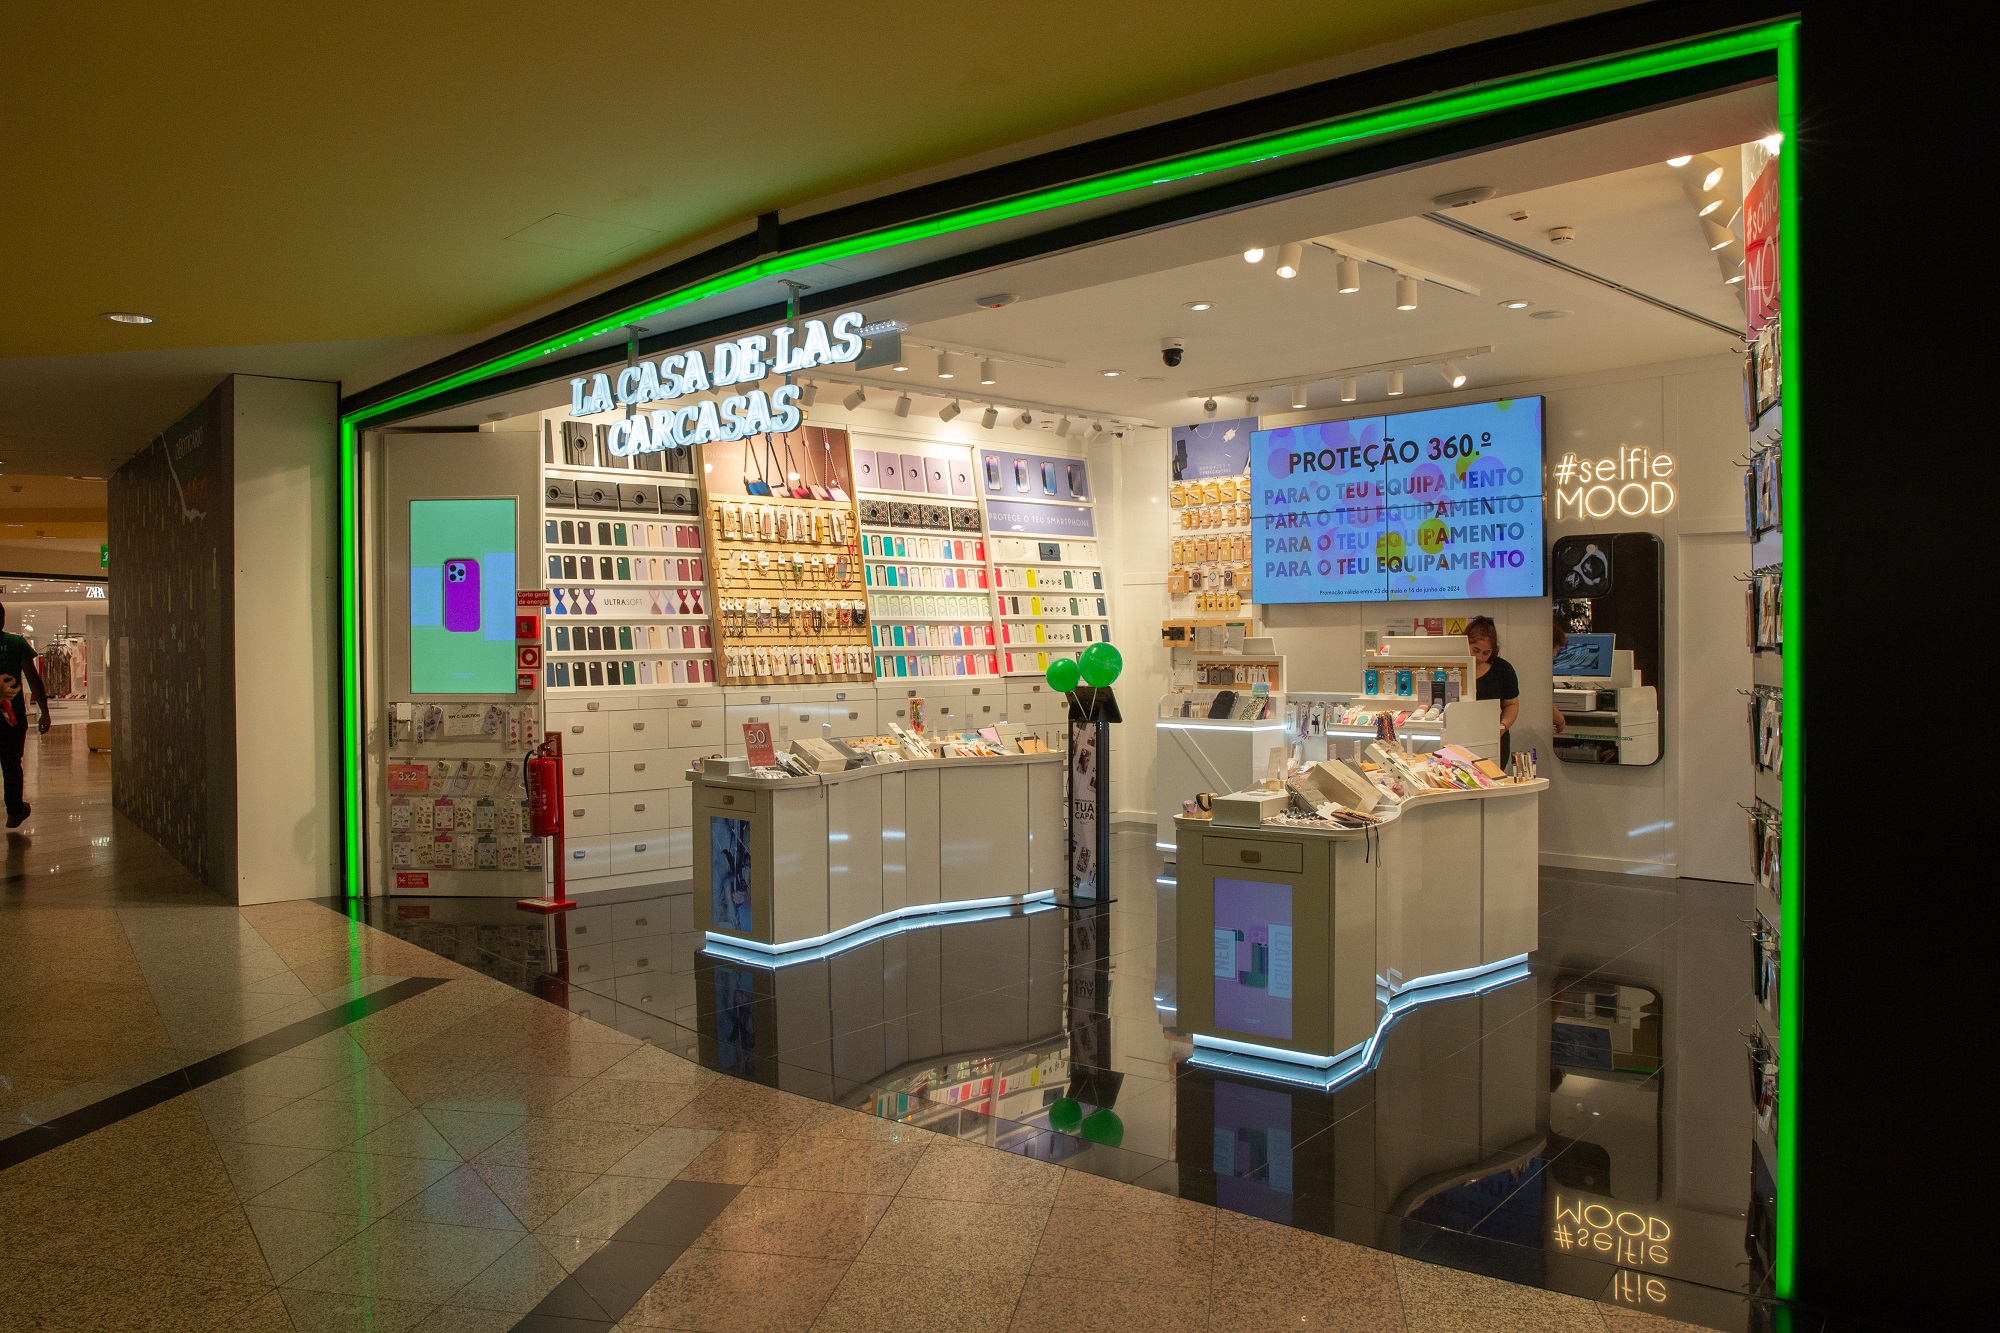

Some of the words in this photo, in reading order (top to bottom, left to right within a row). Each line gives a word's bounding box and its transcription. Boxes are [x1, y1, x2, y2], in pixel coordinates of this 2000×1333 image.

[1747, 178, 1780, 247] #somo
[1748, 222, 1780, 325] MO
[569, 372, 616, 417] LA
[617, 350, 711, 404] CASA
[714, 335, 768, 386] DE
[772, 312, 864, 374] LAS
[608, 384, 802, 456] CARCASAS
[1289, 437, 1419, 474] PROTEÇÃO
[1555, 446, 1673, 484] #selfie
[1264, 487, 1310, 506] PARA
[1316, 484, 1330, 502] O
[1336, 481, 1368, 500] TEU
[1376, 467, 1524, 496] EQUIPAMENTO
[1557, 482, 1674, 520] MOOD
[989, 512, 1020, 522] PROTEGE
[1047, 517, 1090, 527] SMARTPHONE
[1264, 511, 1312, 530] PARA
[1317, 509, 1331, 526] O
[1336, 506, 1369, 525] TEU
[1376, 494, 1524, 522] EQUIPAMENTO
[1265, 536, 1312, 554] PARA
[1317, 534, 1332, 551] O
[1337, 532, 1369, 550] TEU
[1376, 522, 1524, 548] EQUIPAMENTO
[1265, 560, 1312, 578] PARA
[1317, 559, 1331, 576] O
[1337, 557, 1369, 575] TEU
[1376, 550, 1524, 574] EQUIPAMENTO
[86, 586, 106, 598] ZARA
[398, 772, 417, 780] 3x2
[1075, 802, 1094, 813] TUA
[1075, 812, 1094, 820] CAPA
